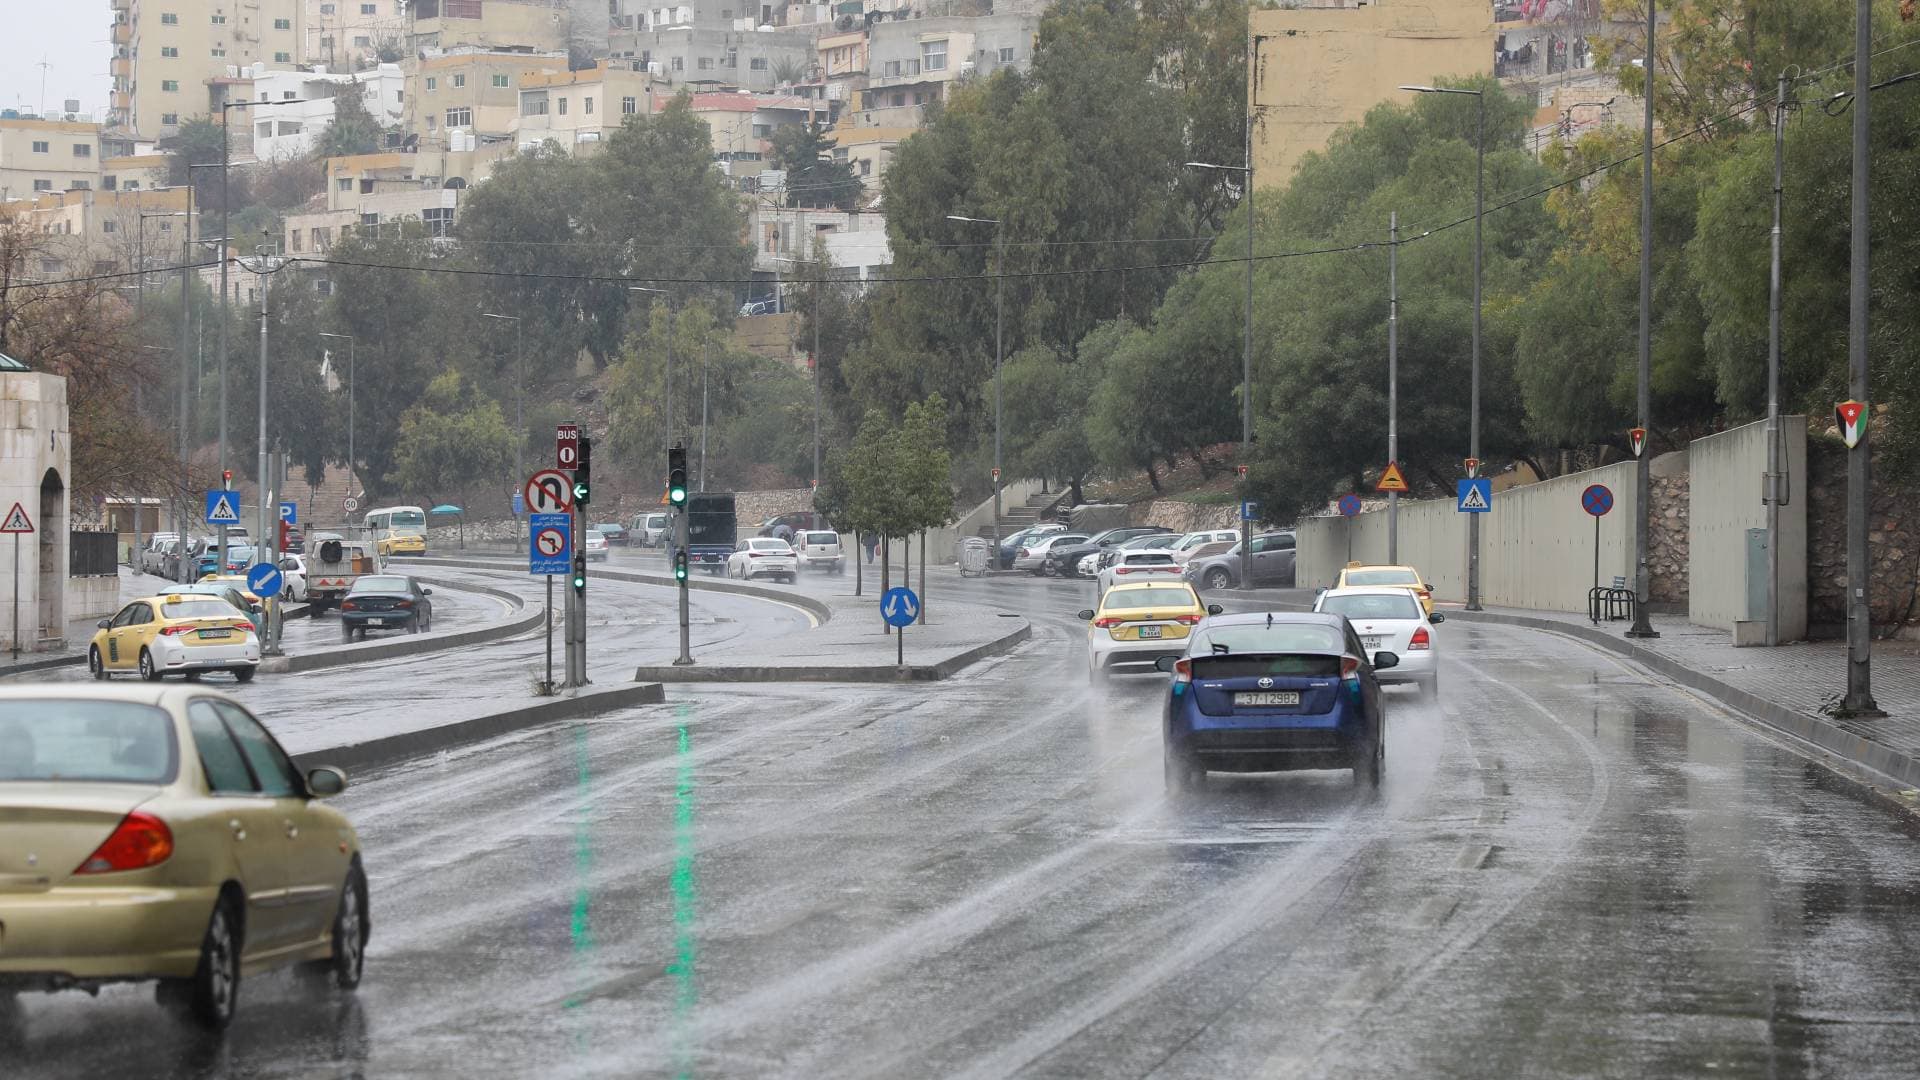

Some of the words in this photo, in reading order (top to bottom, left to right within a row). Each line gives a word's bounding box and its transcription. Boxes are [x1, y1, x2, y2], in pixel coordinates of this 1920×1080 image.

[557, 430, 577, 440] BUS
[346, 500, 356, 509] 50
[280, 506, 292, 521] P
